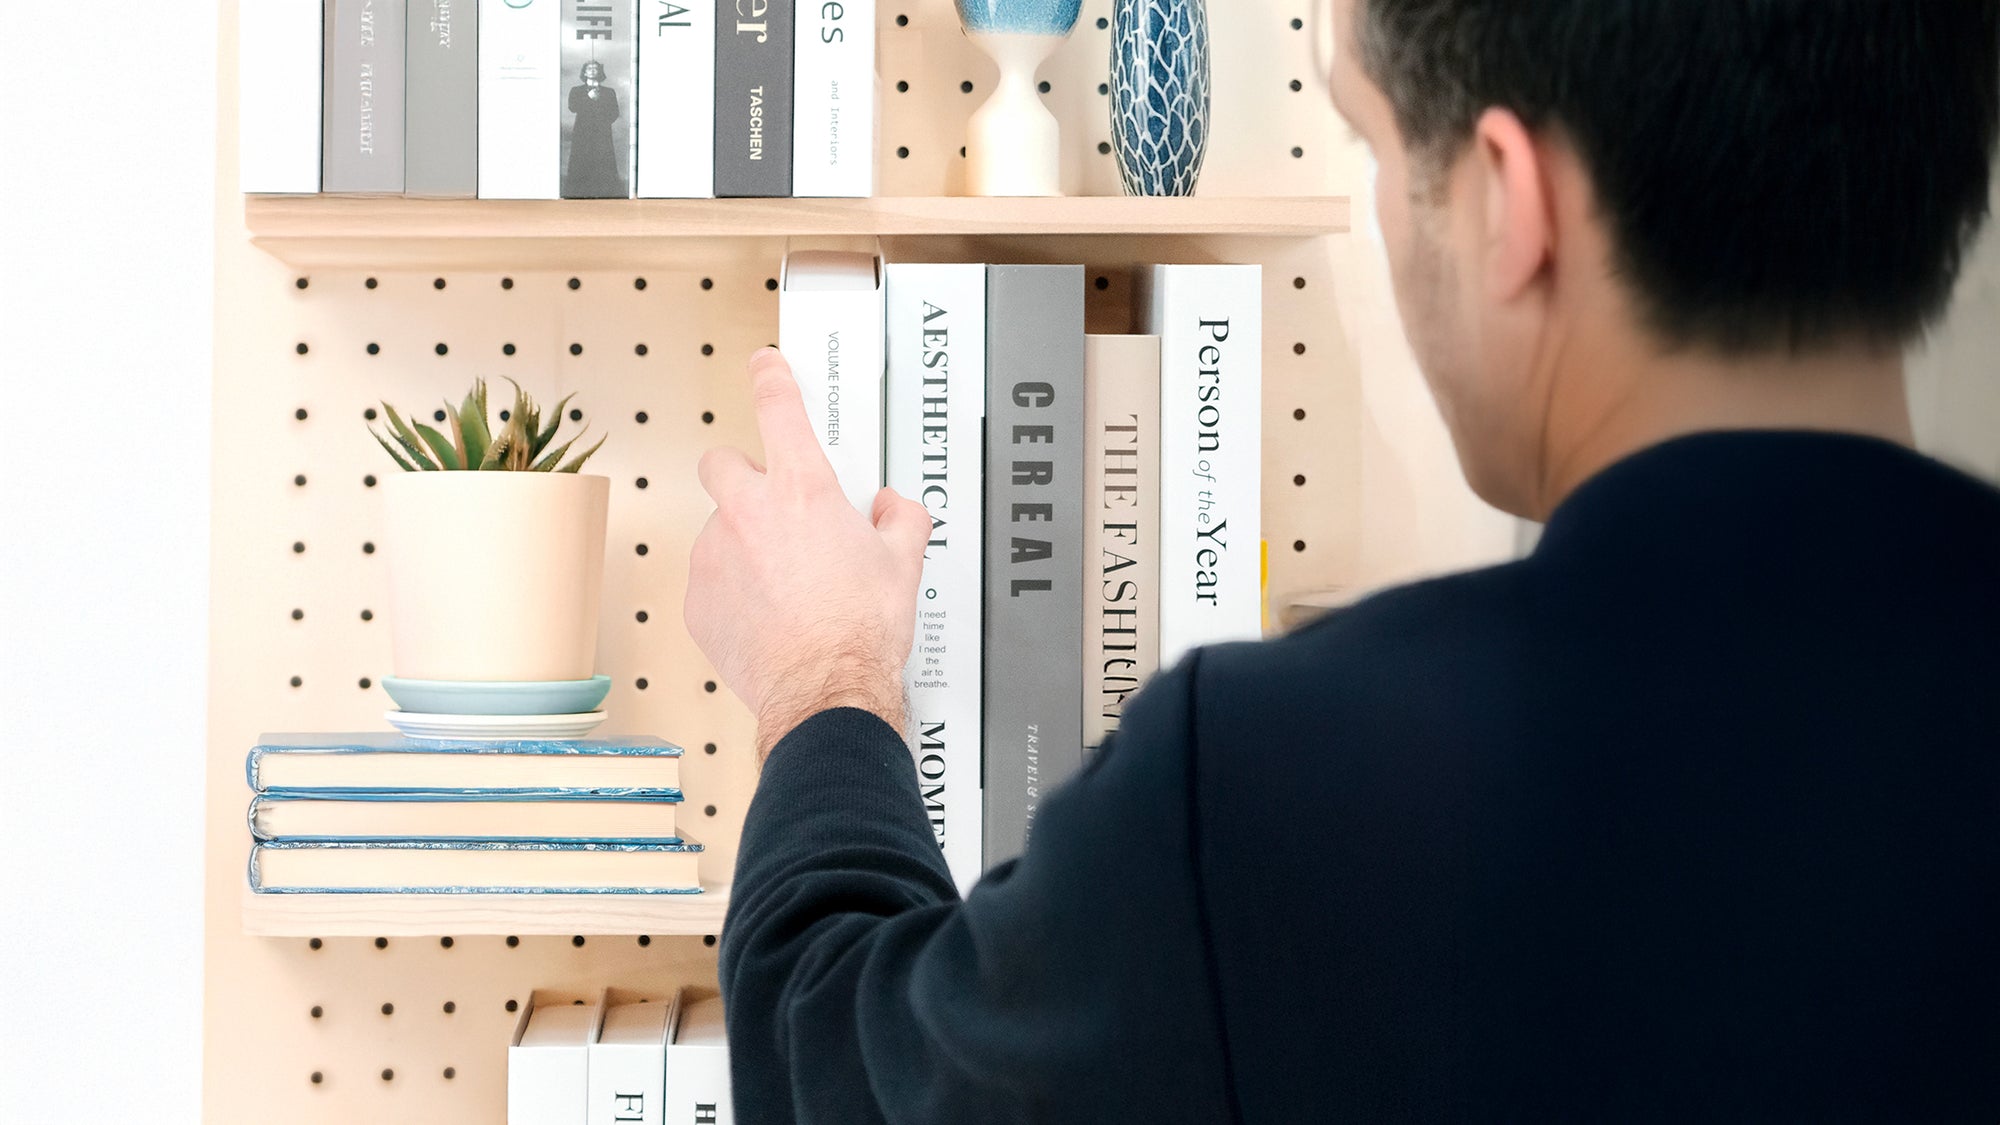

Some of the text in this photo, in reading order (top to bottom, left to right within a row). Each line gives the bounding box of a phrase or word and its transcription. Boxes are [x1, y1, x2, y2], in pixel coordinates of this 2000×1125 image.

[576, 0, 613, 40] IFE
[749, 85, 763, 161] TASCHEN
[829, 80, 840, 166] and Interiors
[827, 331, 840, 447] VOLUME FOURTEEN
[1103, 414, 1139, 510] THE
[1192, 316, 1230, 608] Person of the Year
[1011, 381, 1056, 598] CEREAL
[918, 610, 947, 620] I need
[923, 622, 945, 631] hime
[918, 645, 947, 654] I need
[925, 634, 941, 642] like
[921, 669, 944, 677] air to
[925, 657, 940, 665] the
[914, 680, 951, 689] breathe.
